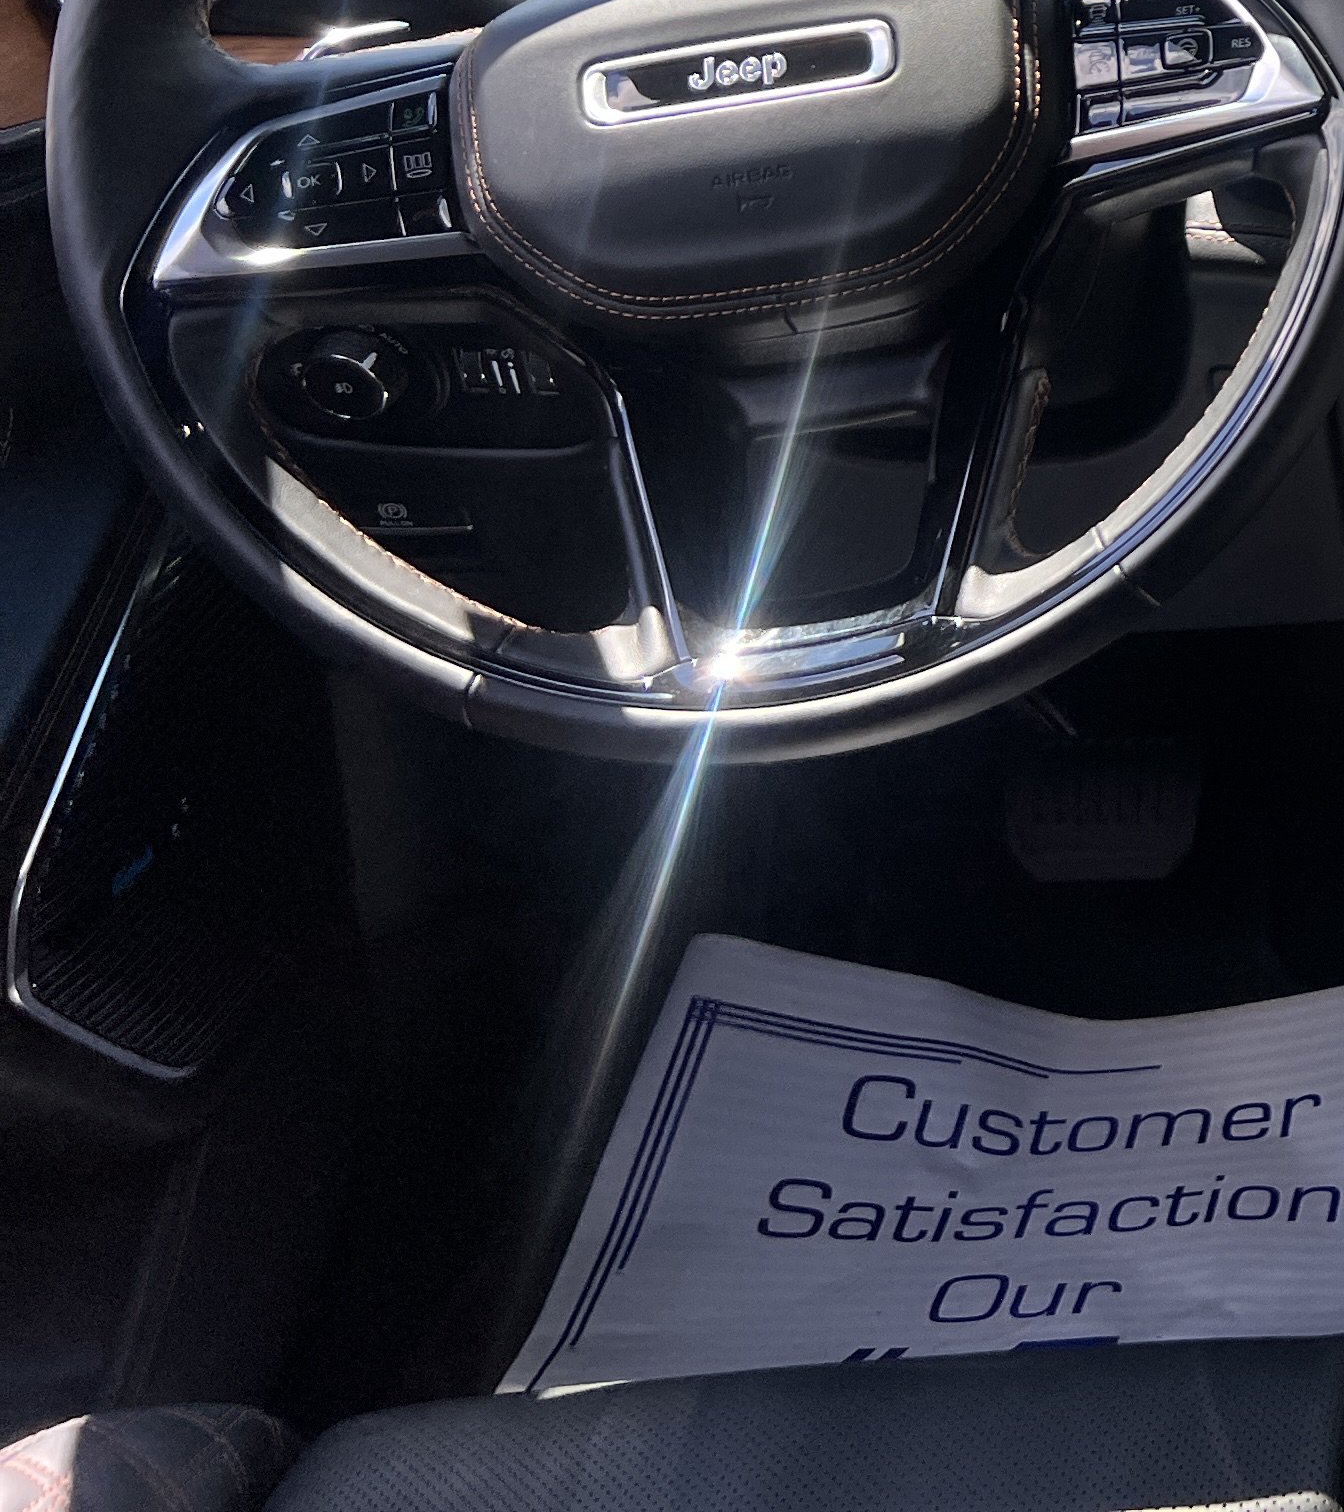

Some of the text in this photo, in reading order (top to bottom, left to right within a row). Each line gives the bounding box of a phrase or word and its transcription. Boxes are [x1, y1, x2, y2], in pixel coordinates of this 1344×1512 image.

[1231, 38, 1251, 49] RES
[687, 51, 788, 91] Jeep
[297, 174, 321, 188] OK
[841, 1074, 1323, 1158] Customer
[757, 1175, 1343, 1245] Satisfaction
[929, 1273, 1123, 1324] Our
